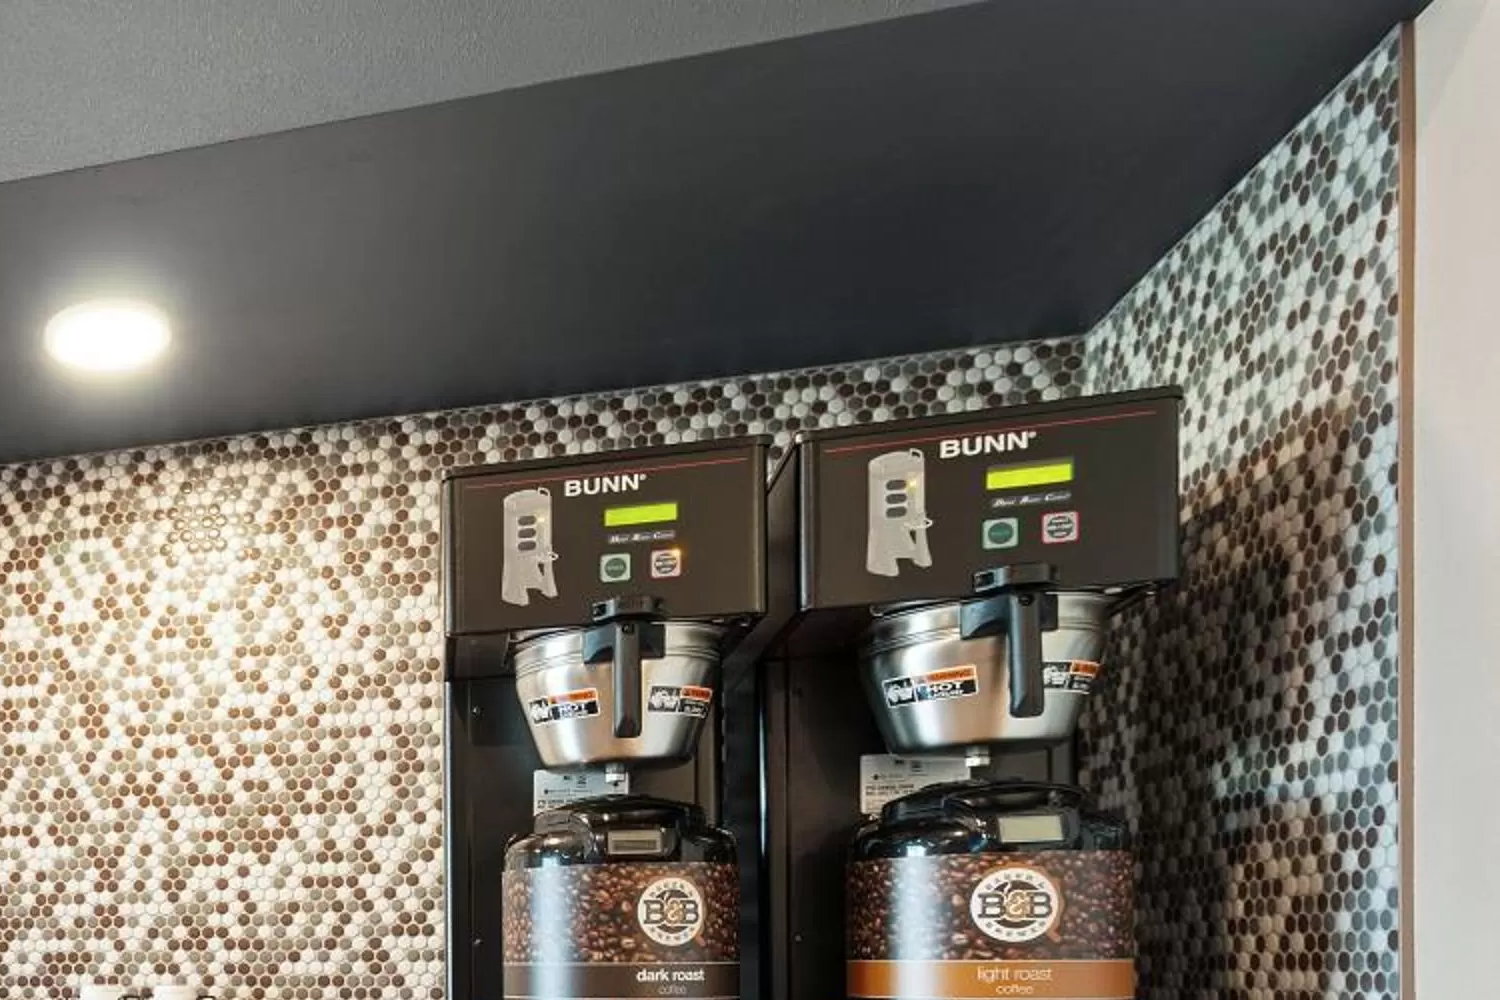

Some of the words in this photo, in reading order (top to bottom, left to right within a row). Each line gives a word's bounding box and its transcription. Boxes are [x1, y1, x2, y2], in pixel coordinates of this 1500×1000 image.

[939, 431, 1028, 459] BUNN
[564, 473, 640, 497] BUNN
[978, 891, 1052, 919] B&B
[636, 968, 669, 982] dark
[673, 969, 705, 981] roast
[977, 966, 1009, 983] light
[1014, 968, 1052, 981] roast
[996, 984, 1033, 995] coffee
